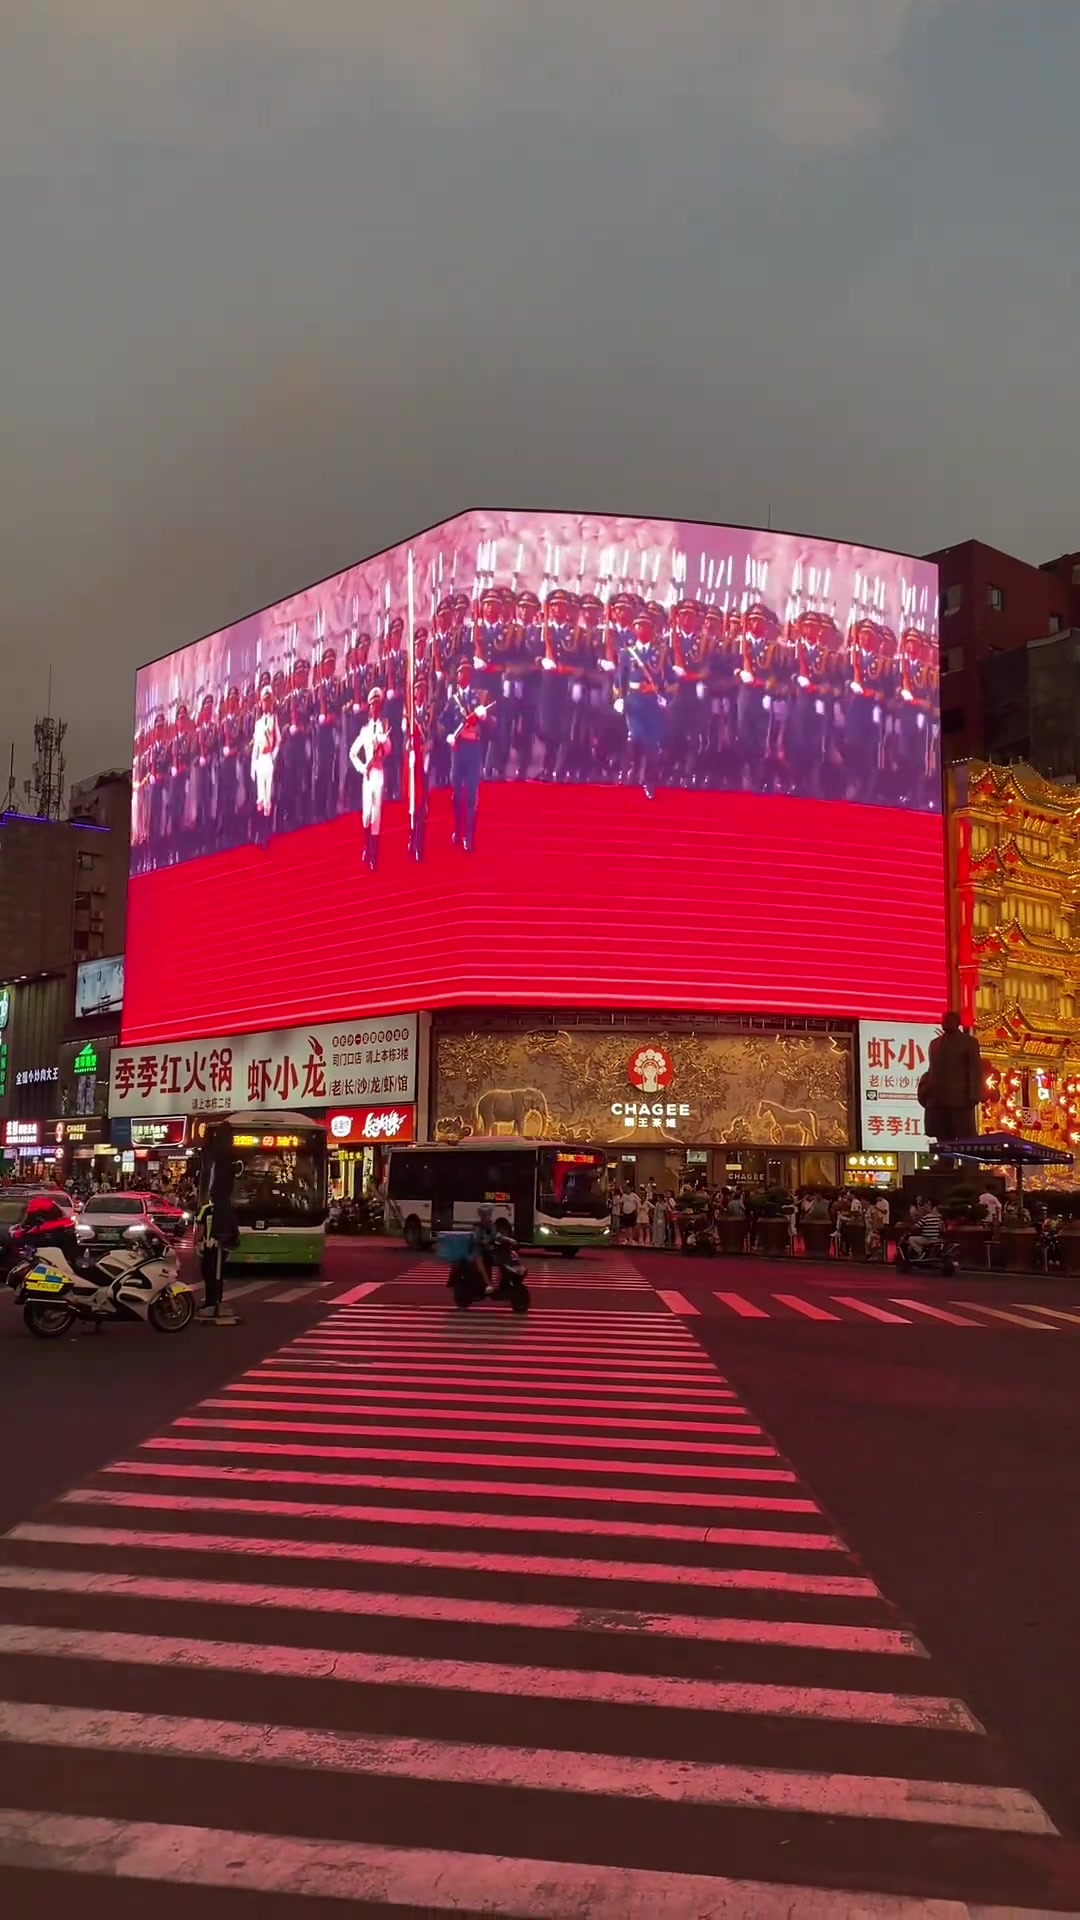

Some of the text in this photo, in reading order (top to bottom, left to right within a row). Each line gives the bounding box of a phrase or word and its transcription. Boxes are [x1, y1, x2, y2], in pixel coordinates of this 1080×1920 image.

[332, 1051, 362, 1067] 司门口店
[867, 1037, 925, 1070] 虾小
[115, 1048, 232, 1098] 季季红火锅
[248, 1036, 326, 1102] 虾小龙
[191, 1097, 232, 1110] 请上本栋二楼
[611, 1103, 690, 1116] CHAGEE
[868, 1116, 926, 1136] 季季红
